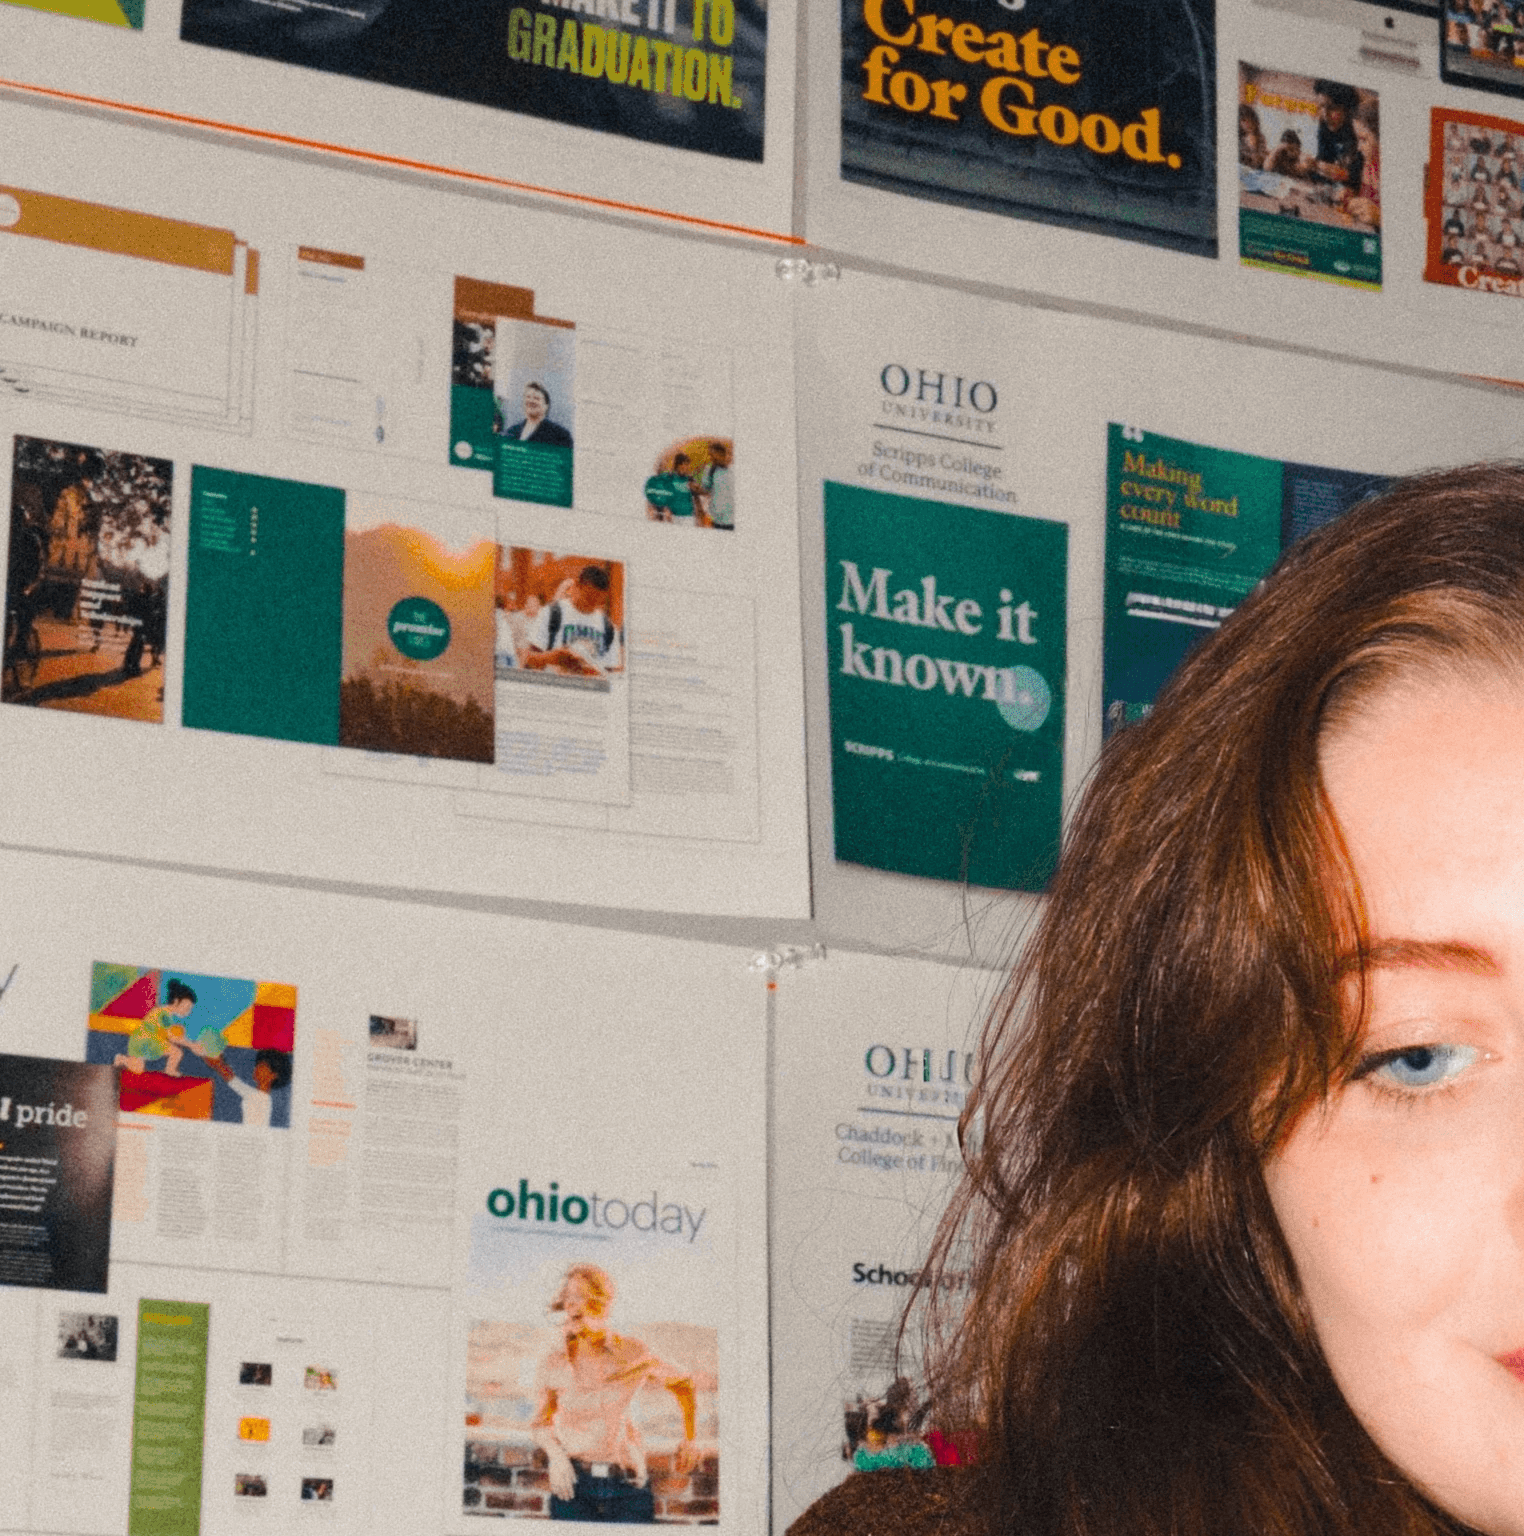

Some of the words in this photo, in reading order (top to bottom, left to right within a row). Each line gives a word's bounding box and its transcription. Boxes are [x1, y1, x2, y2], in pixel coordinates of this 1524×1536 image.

[691, 0, 735, 47] TO
[863, 0, 1082, 85] Create
[507, 7, 742, 109] GRADUATION.
[861, 45, 969, 121] for
[979, 76, 1183, 169] Good.
[80, 326, 138, 348] REPORT
[880, 363, 998, 414] OHIO
[882, 400, 997, 434] UNIVERSITY
[872, 440, 937, 468] Scripps
[939, 451, 1002, 481] College
[1122, 450, 1203, 495] Making
[857, 461, 876, 478] of
[879, 463, 1018, 505] Communication
[1120, 480, 1177, 510] every
[1183, 496, 1240, 517] word
[1120, 504, 1181, 528] count
[836, 558, 984, 636] Make
[996, 586, 1038, 646] it
[839, 620, 1035, 707] known.
[412, 1057, 453, 1070] CENTER
[14, 1101, 89, 1129] pride
[835, 1122, 924, 1149] Chaddock
[838, 1145, 904, 1172] College
[906, 1153, 927, 1172] of
[487, 1178, 707, 1243] ohiotoday
